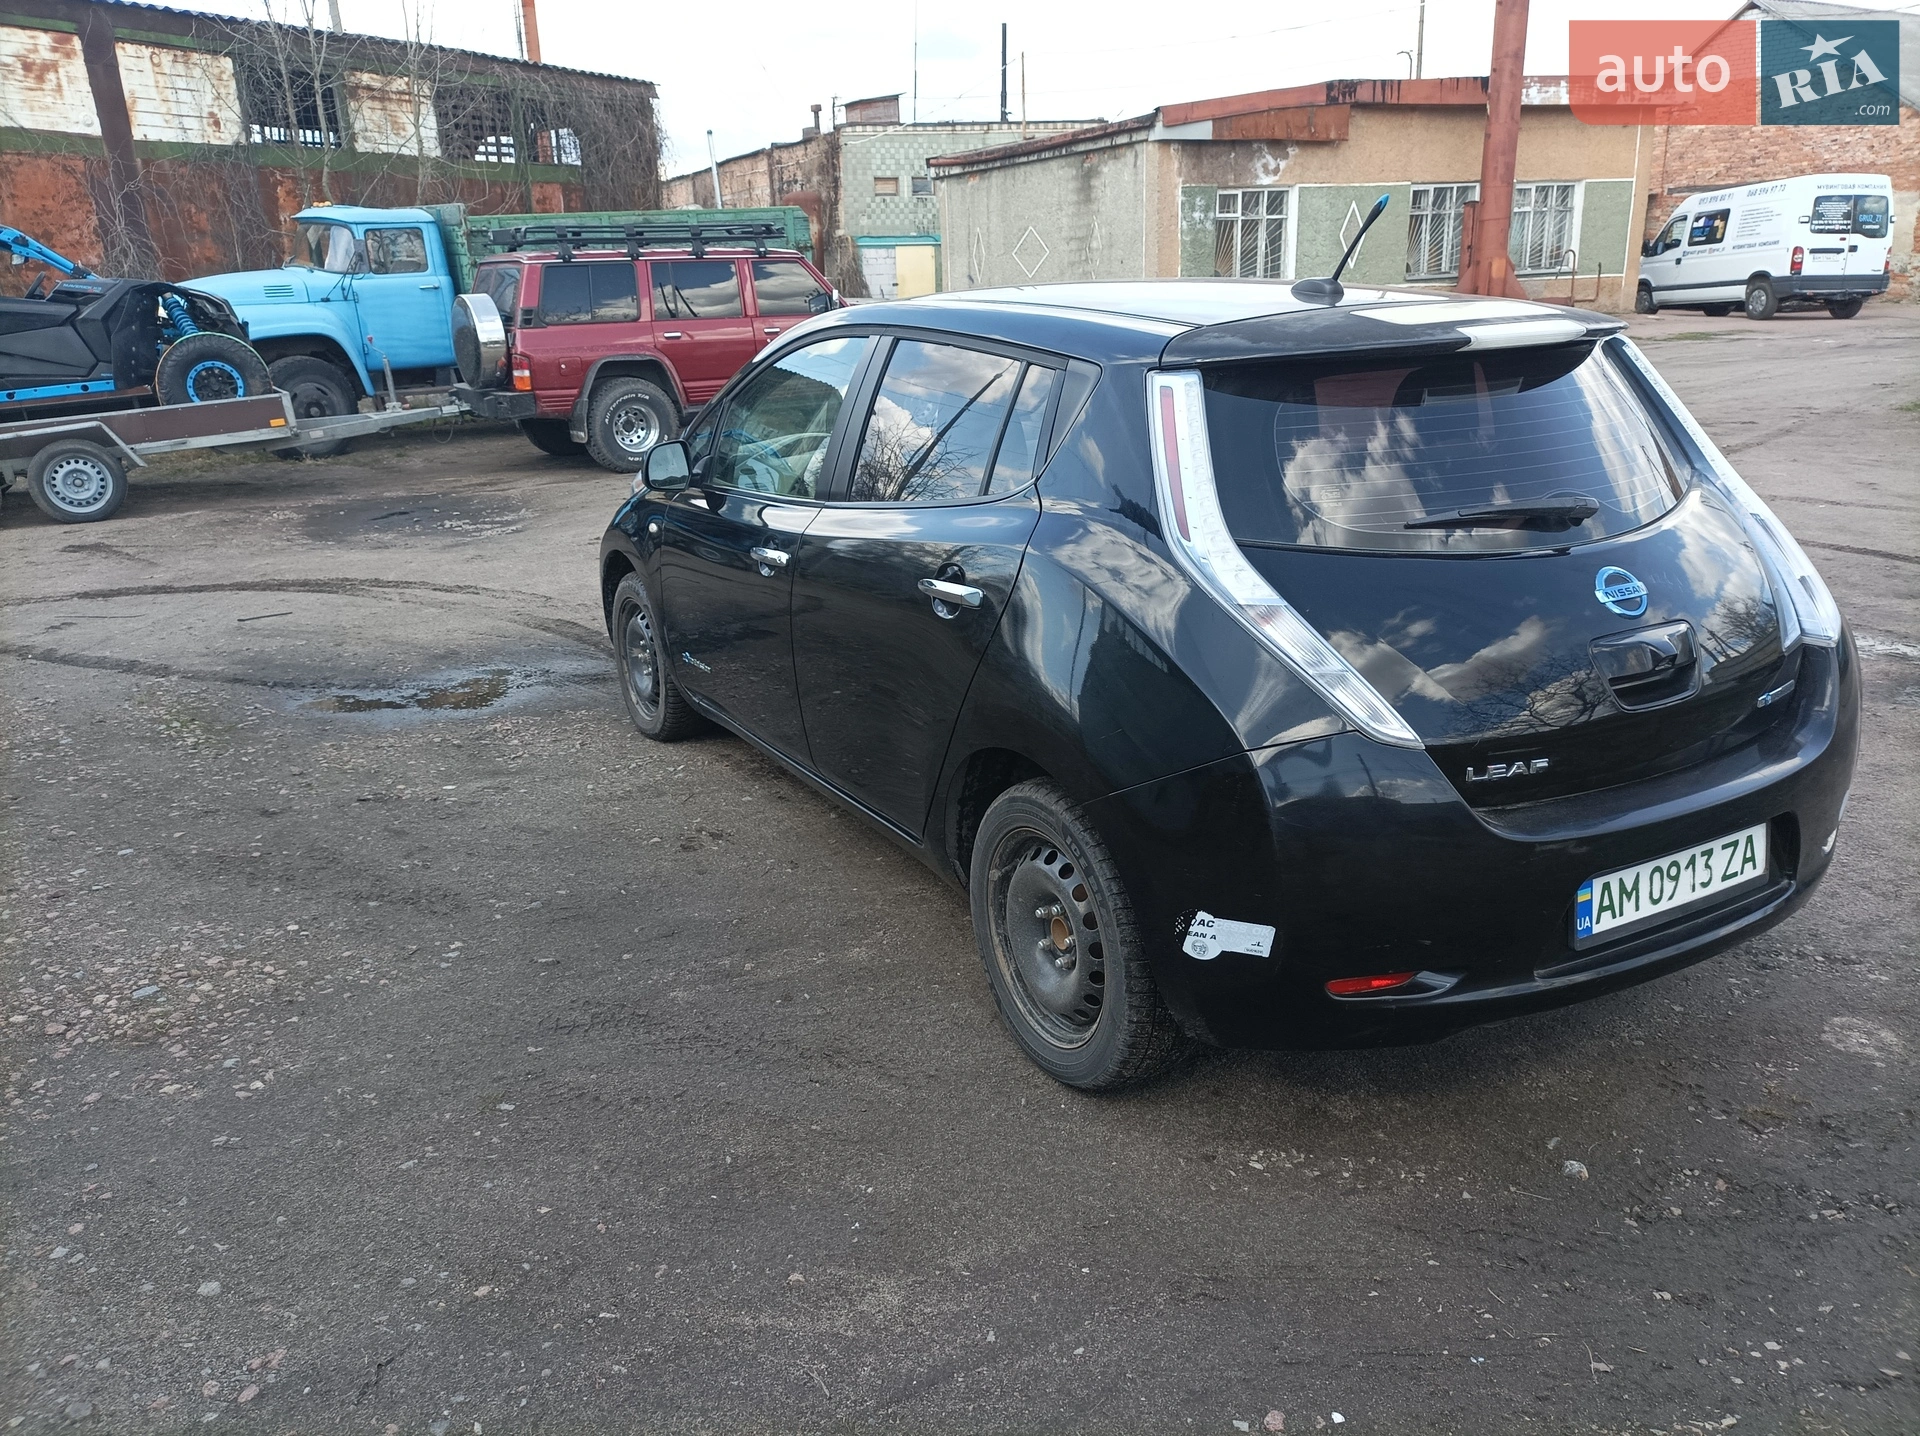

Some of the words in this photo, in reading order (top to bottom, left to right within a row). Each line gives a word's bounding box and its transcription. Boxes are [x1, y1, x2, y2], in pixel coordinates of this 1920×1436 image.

[1605, 585, 1646, 600] NISSAN
[1465, 758, 1549, 781] LEAF
[1595, 871, 1640, 925] AM
[1649, 847, 1714, 906] 0913
[1720, 834, 1757, 883] ZA
[1577, 916, 1591, 931] UA
